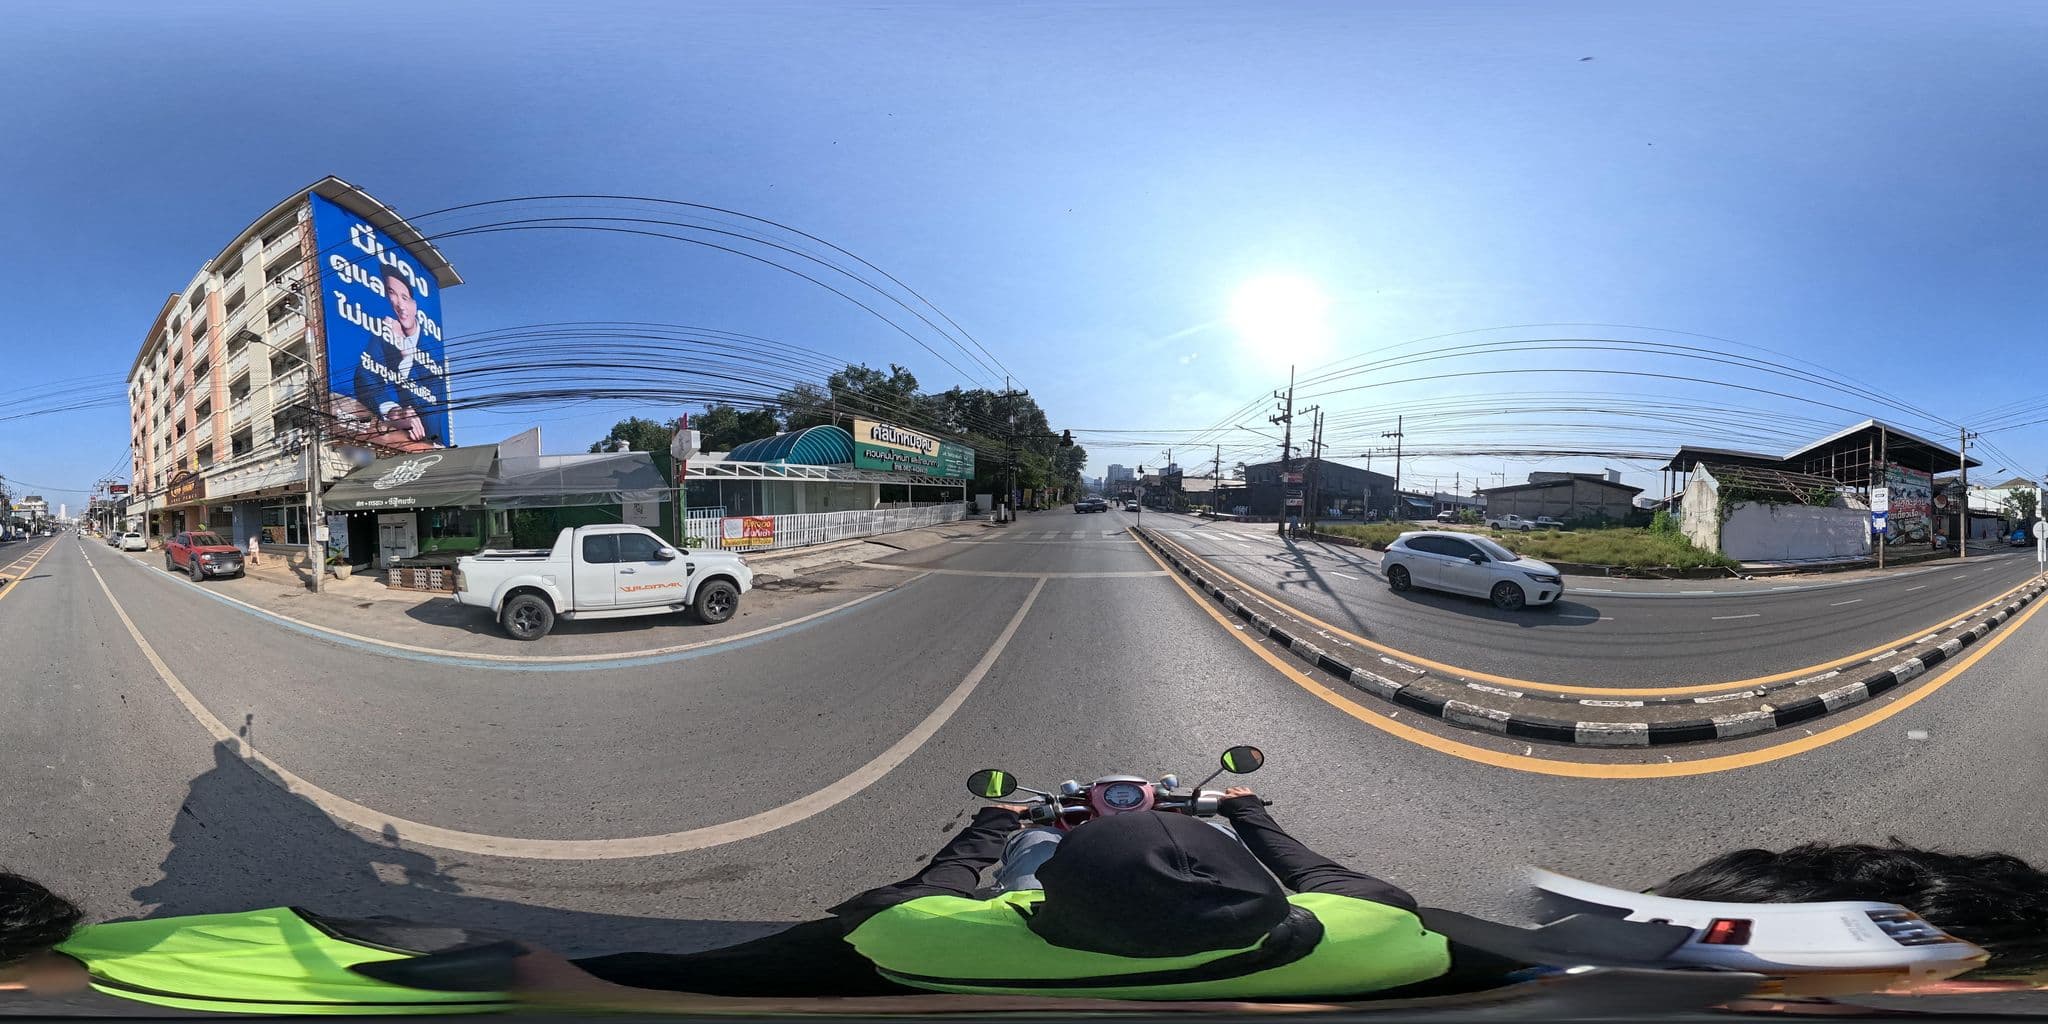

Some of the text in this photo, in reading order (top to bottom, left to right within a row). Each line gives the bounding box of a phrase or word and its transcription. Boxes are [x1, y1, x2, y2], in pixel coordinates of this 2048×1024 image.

[329, 253, 442, 342] ดูแล คุณ
[350, 222, 429, 298] มั่นคง
